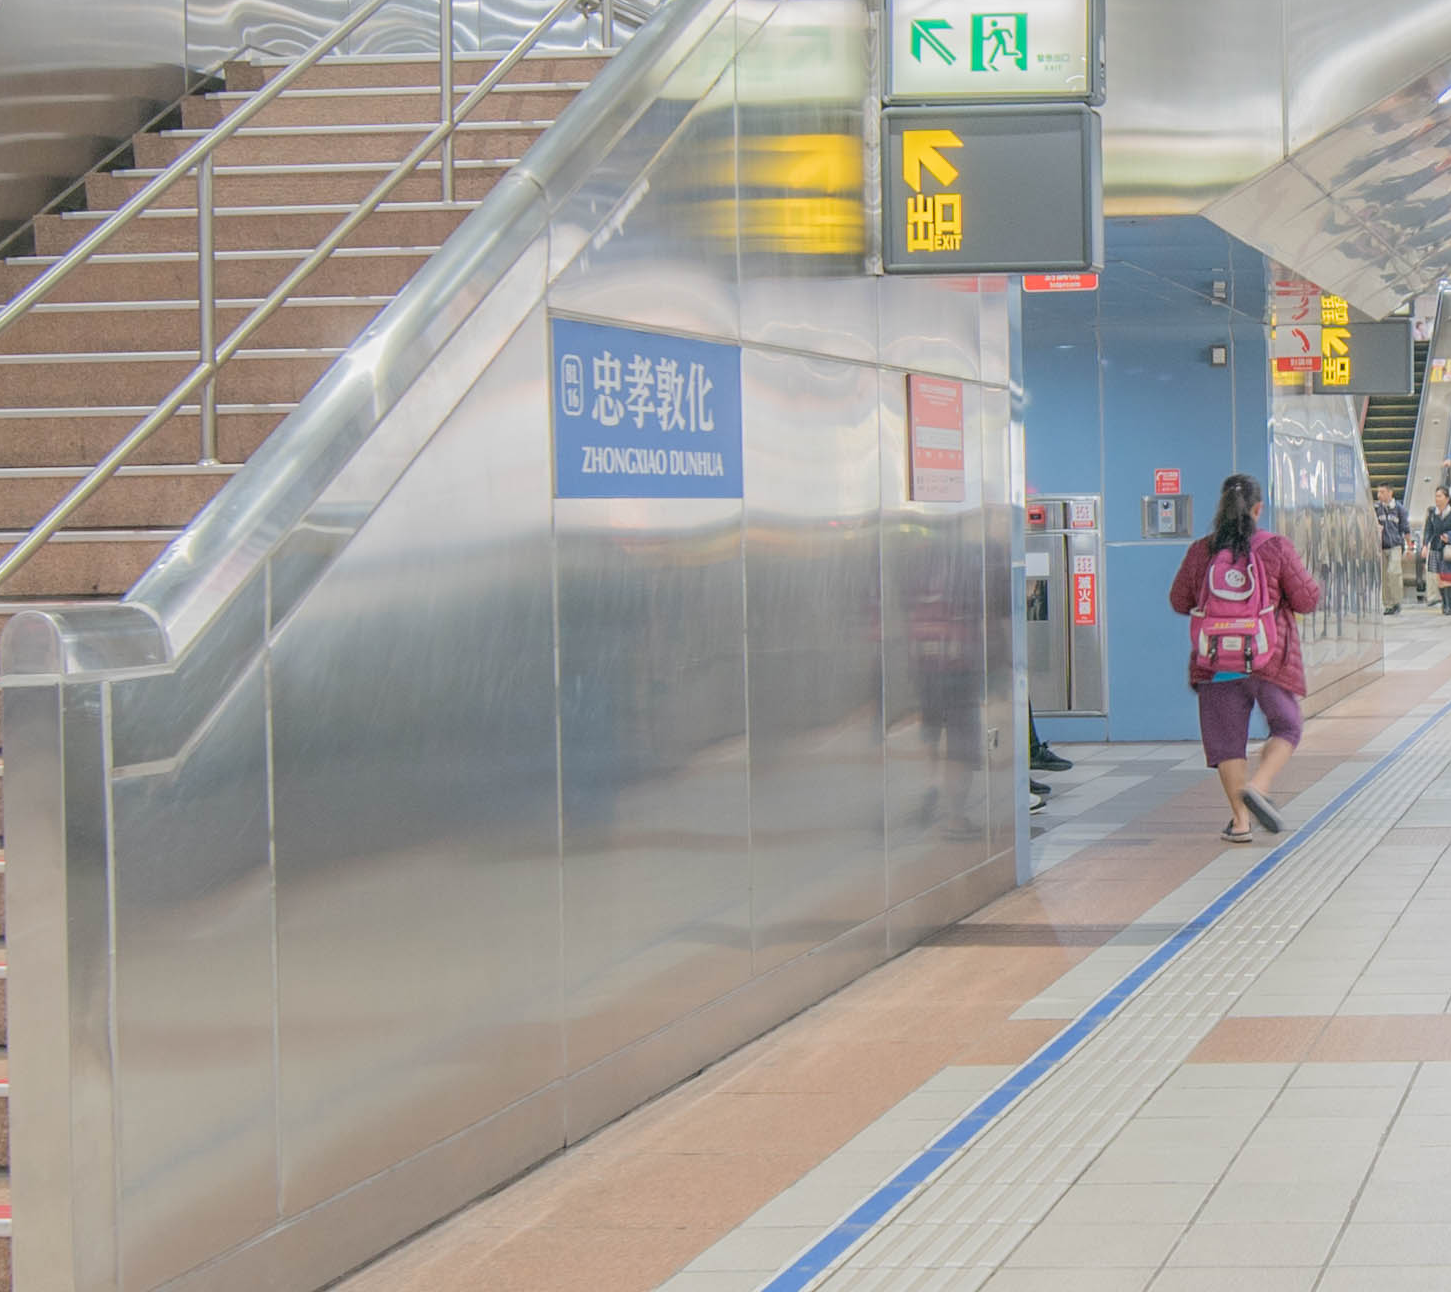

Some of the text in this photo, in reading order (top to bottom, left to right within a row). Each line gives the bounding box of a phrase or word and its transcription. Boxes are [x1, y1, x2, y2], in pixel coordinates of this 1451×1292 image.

[907, 194, 962, 252] 出口
[936, 234, 962, 252] EXIT
[567, 389, 579, 407] 16
[591, 350, 715, 433] 忠孝敦化
[581, 446, 725, 477] ZHONGXIAO DUNHUA
